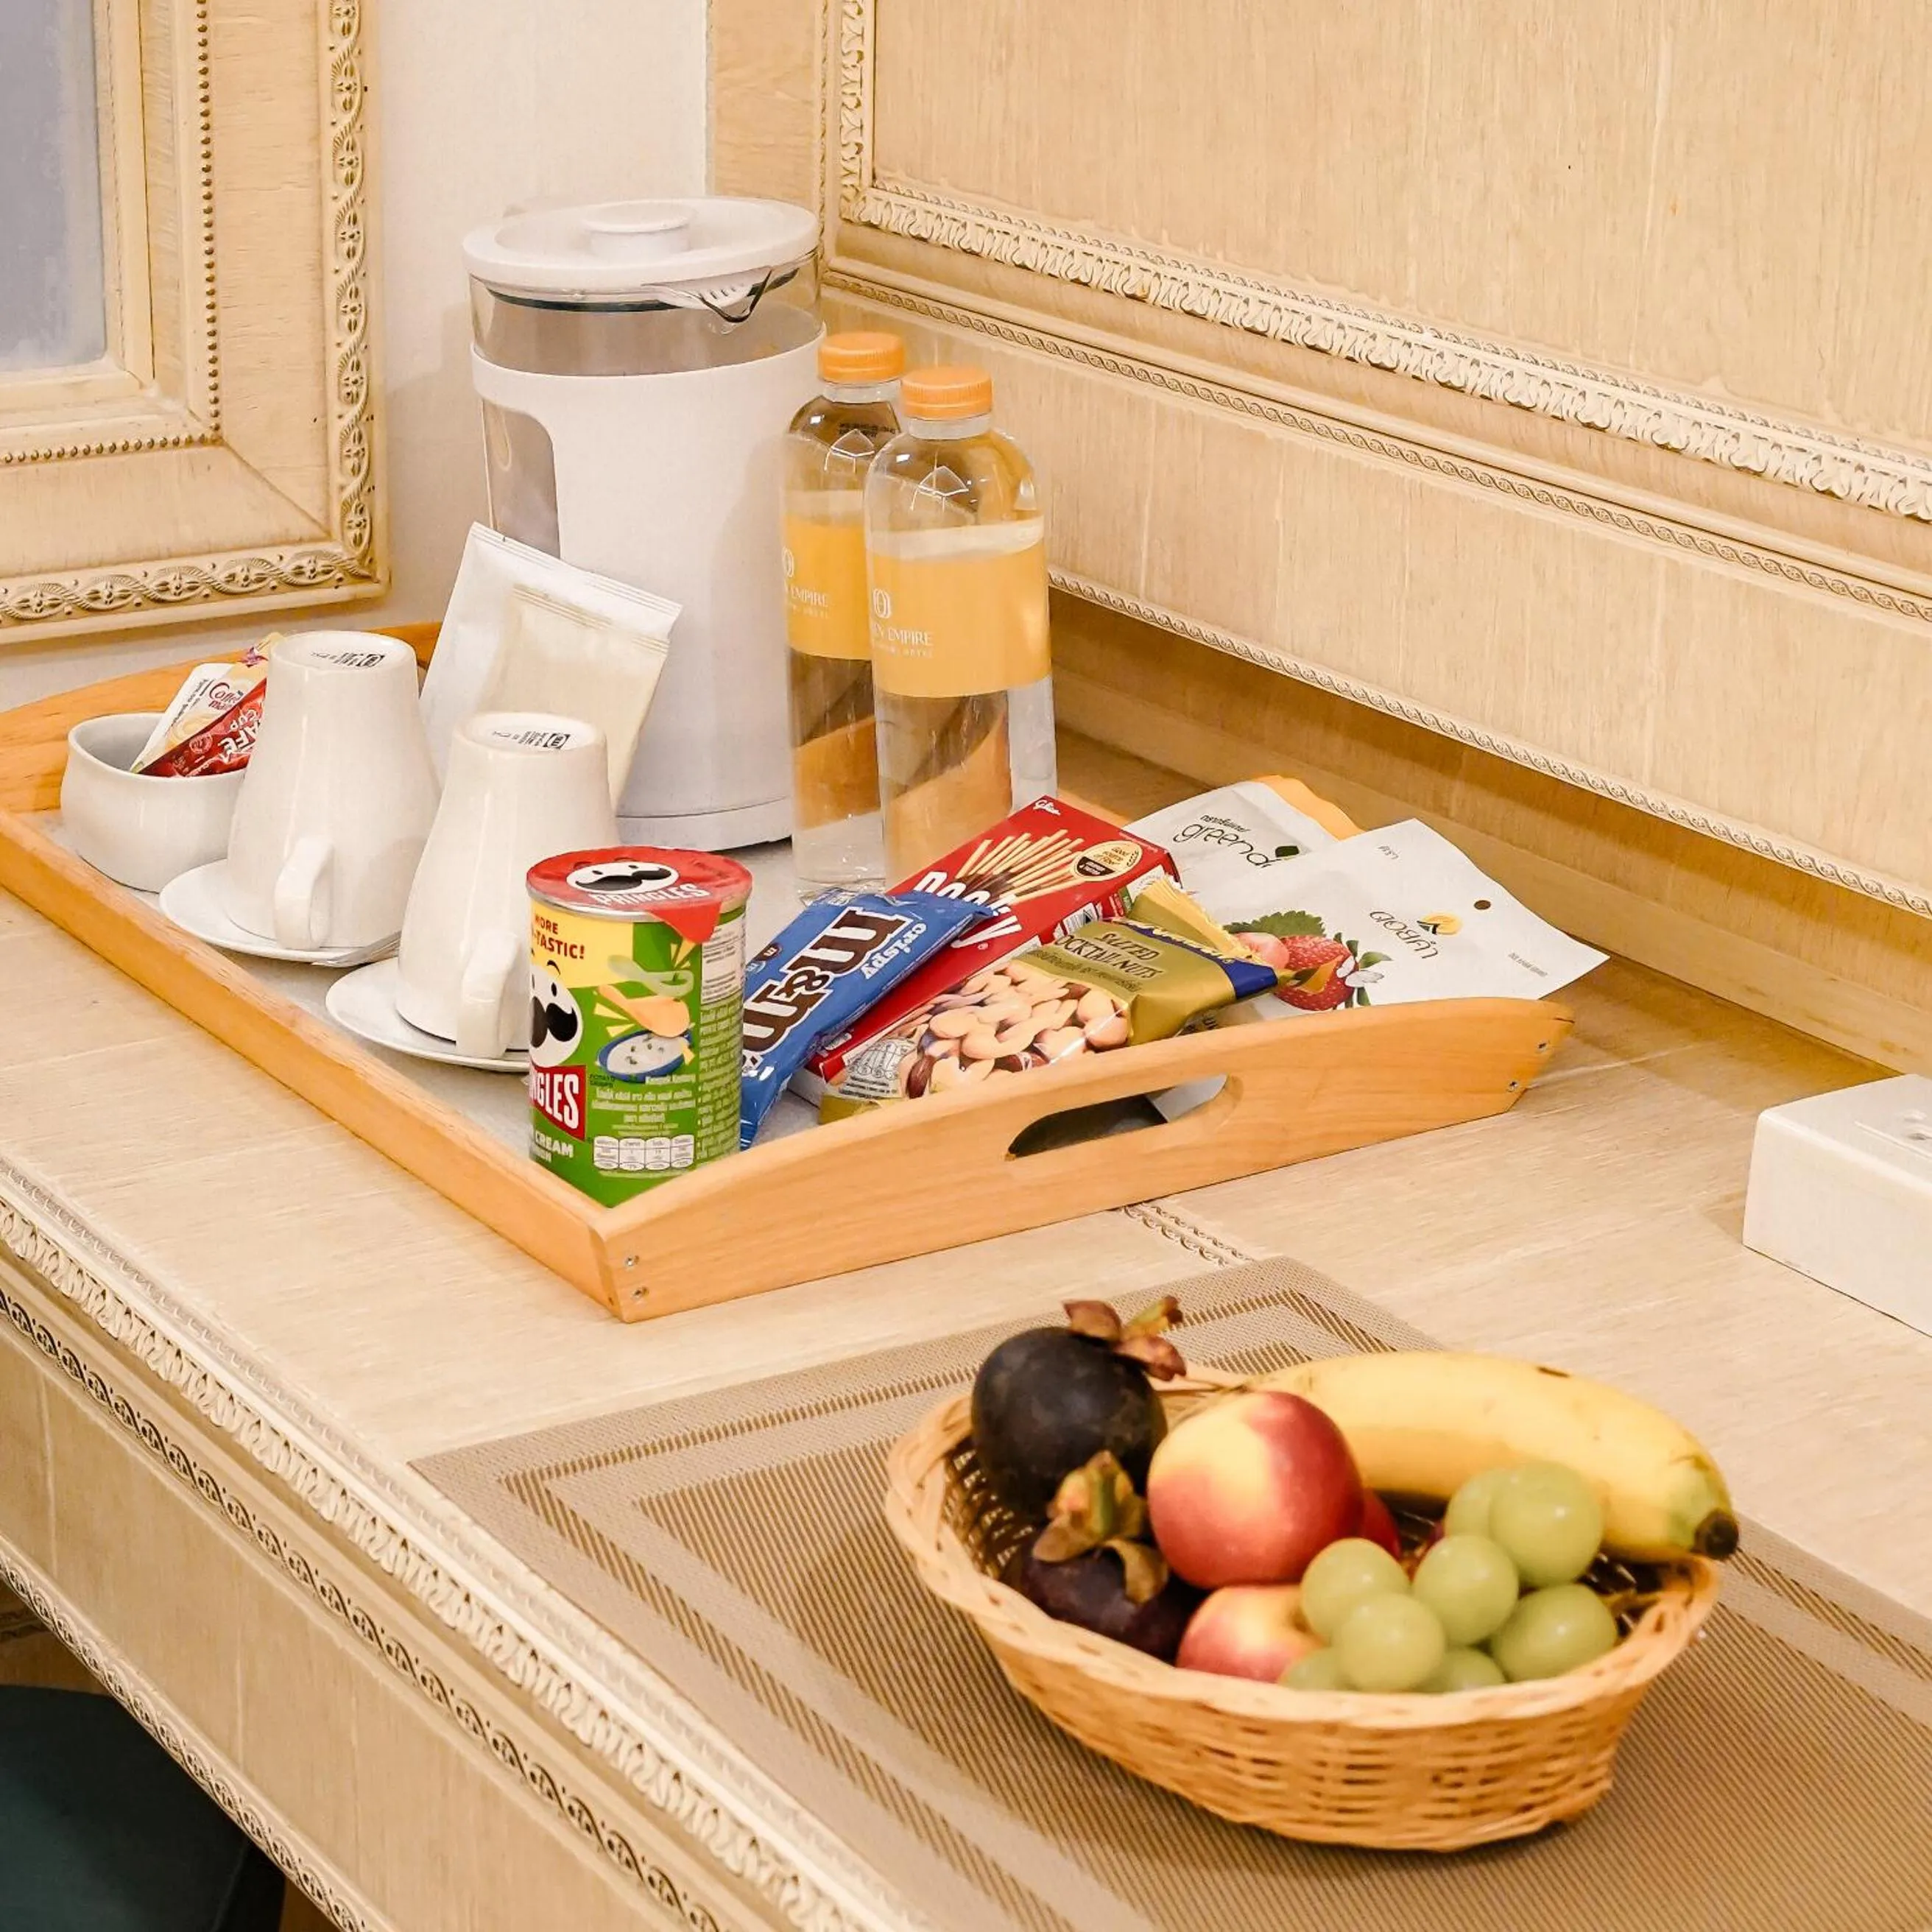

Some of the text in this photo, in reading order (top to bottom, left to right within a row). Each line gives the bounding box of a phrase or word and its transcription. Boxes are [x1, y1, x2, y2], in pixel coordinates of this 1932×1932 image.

[888, 627, 934, 646] EMPIRE
[1172, 823, 1282, 869] greend
[588, 883, 711, 906] PRINGLES
[860, 923, 927, 979] crispy
[1054, 934, 1121, 965] OCKTAIL
[1113, 959, 1164, 979] NUTS
[1094, 933, 1161, 960] SALTED
